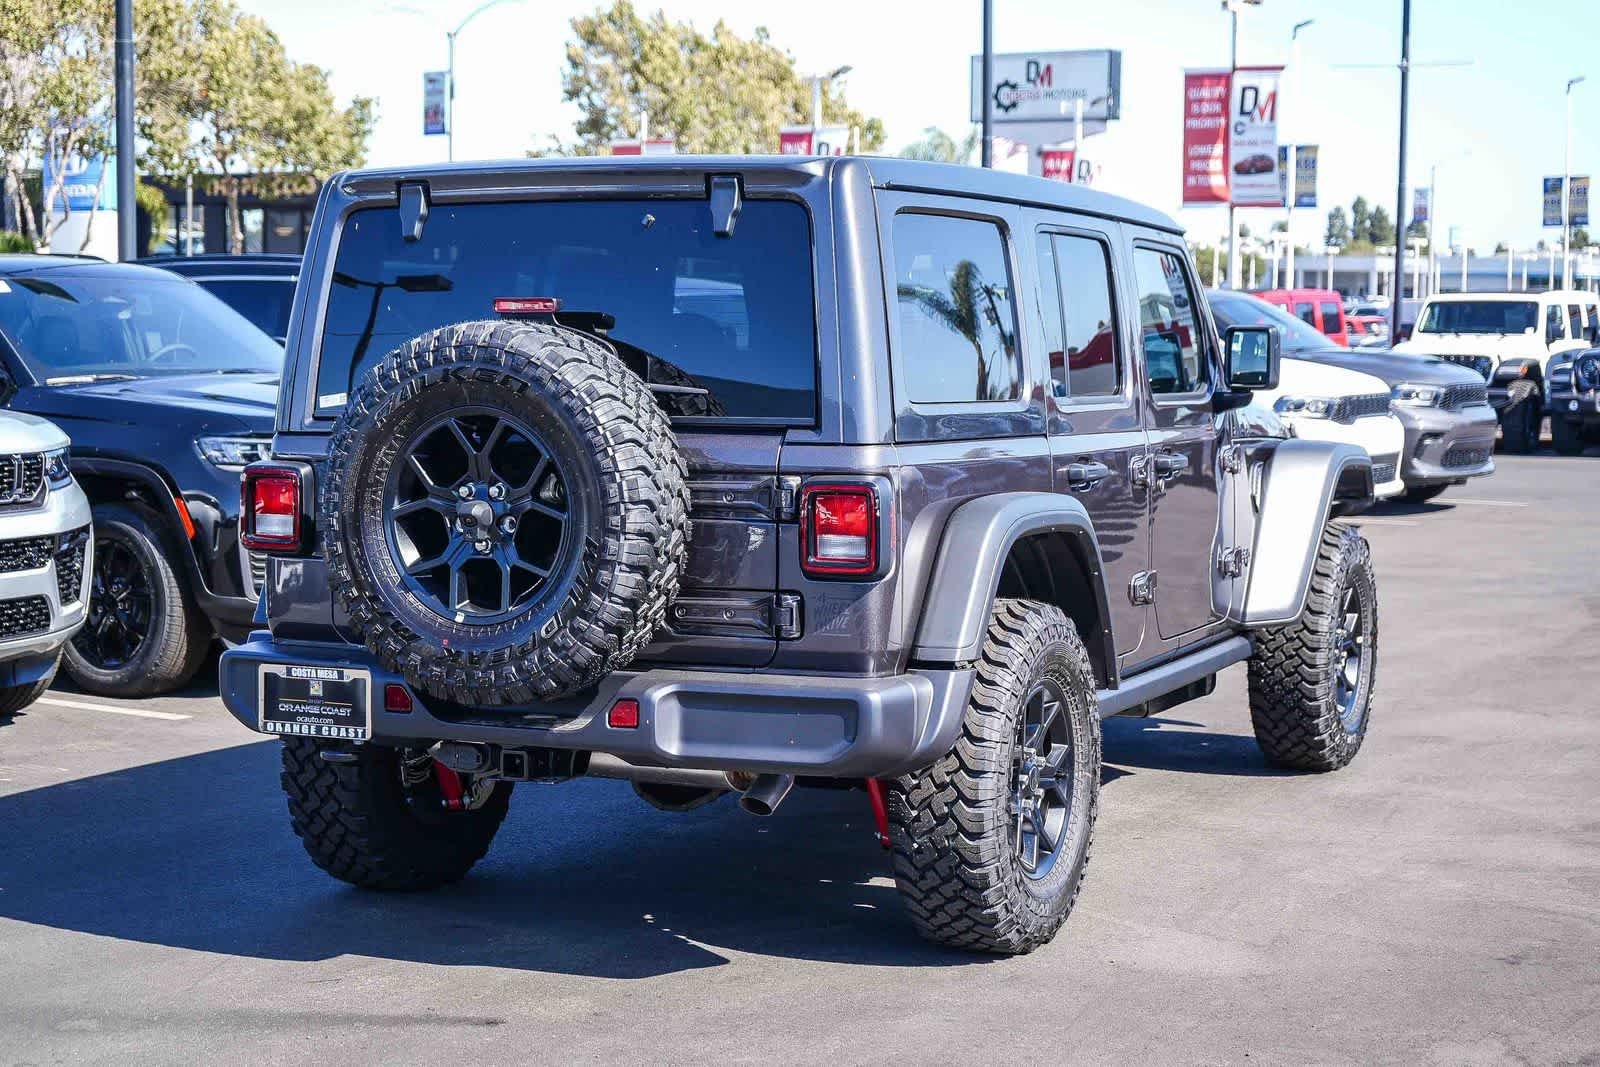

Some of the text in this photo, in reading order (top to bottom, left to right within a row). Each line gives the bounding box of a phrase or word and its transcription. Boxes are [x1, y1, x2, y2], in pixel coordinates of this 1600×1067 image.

[291, 667, 338, 680] COSTA MESA
[278, 703, 352, 717] ORANGE COAST
[296, 716, 334, 725] ocauto.com
[266, 722, 364, 738] ORANGE COAST
